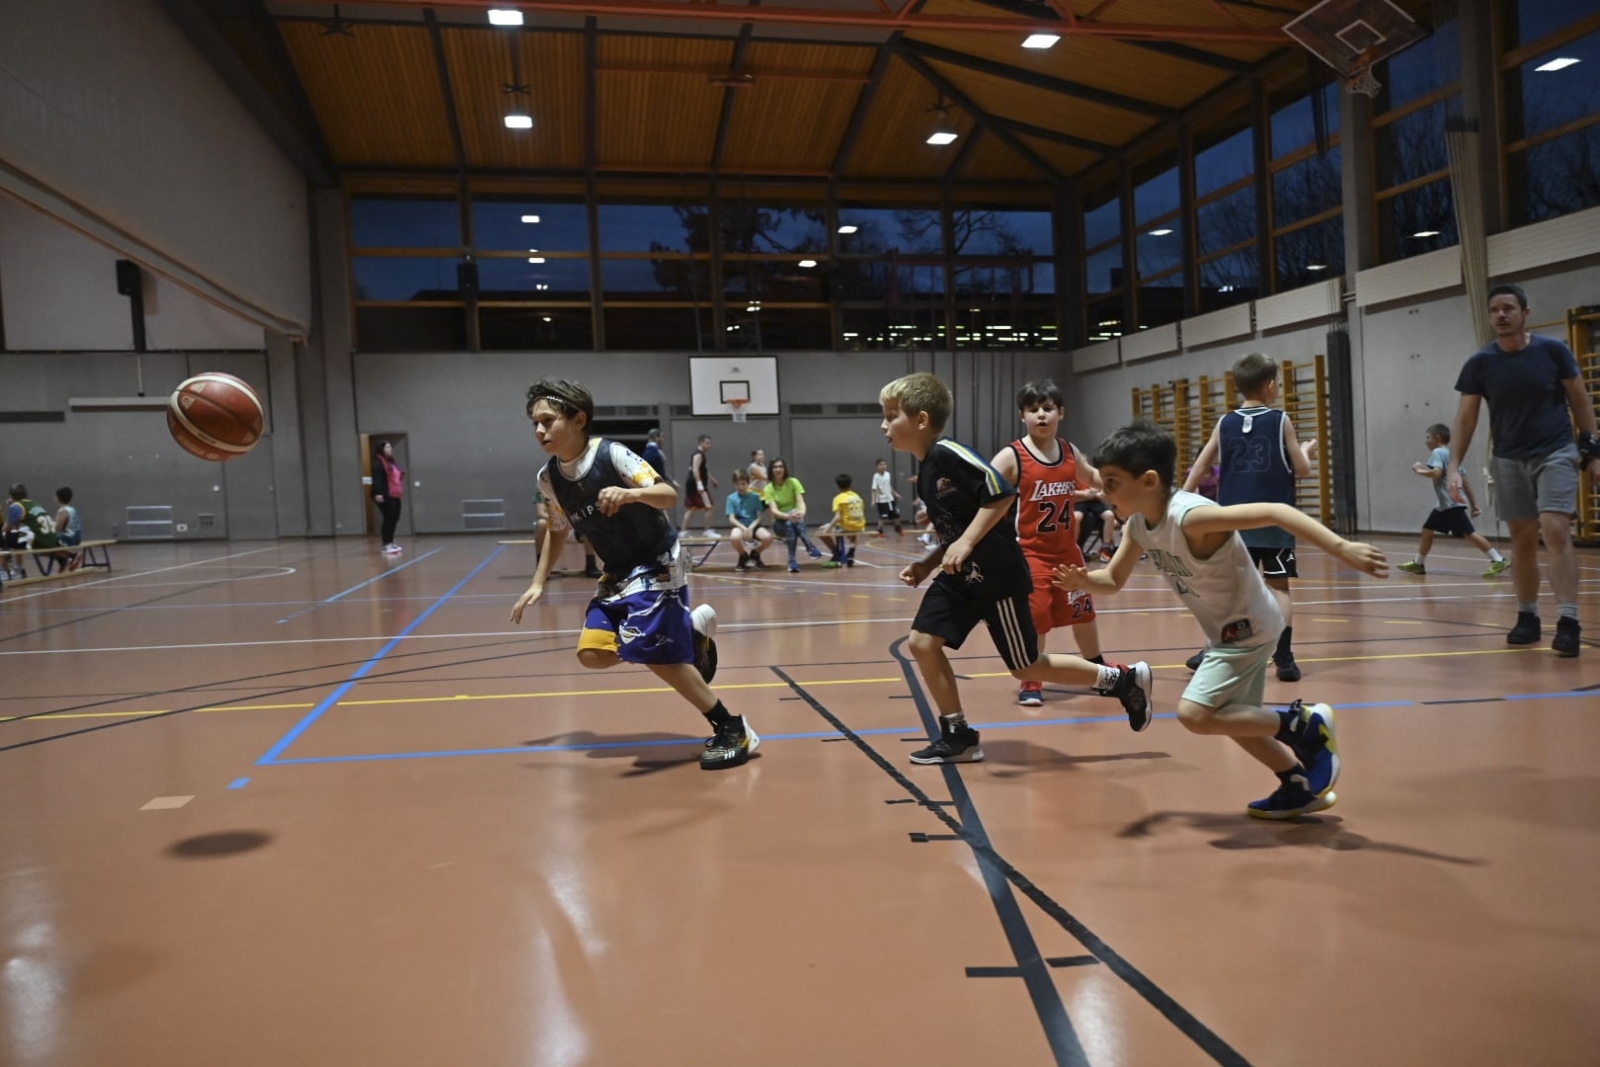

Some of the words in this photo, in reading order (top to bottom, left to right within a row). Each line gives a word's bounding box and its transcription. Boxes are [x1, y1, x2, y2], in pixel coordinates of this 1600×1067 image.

[1229, 436, 1271, 473] 23
[1037, 500, 1070, 533] 24
[1072, 596, 1094, 620] 24
